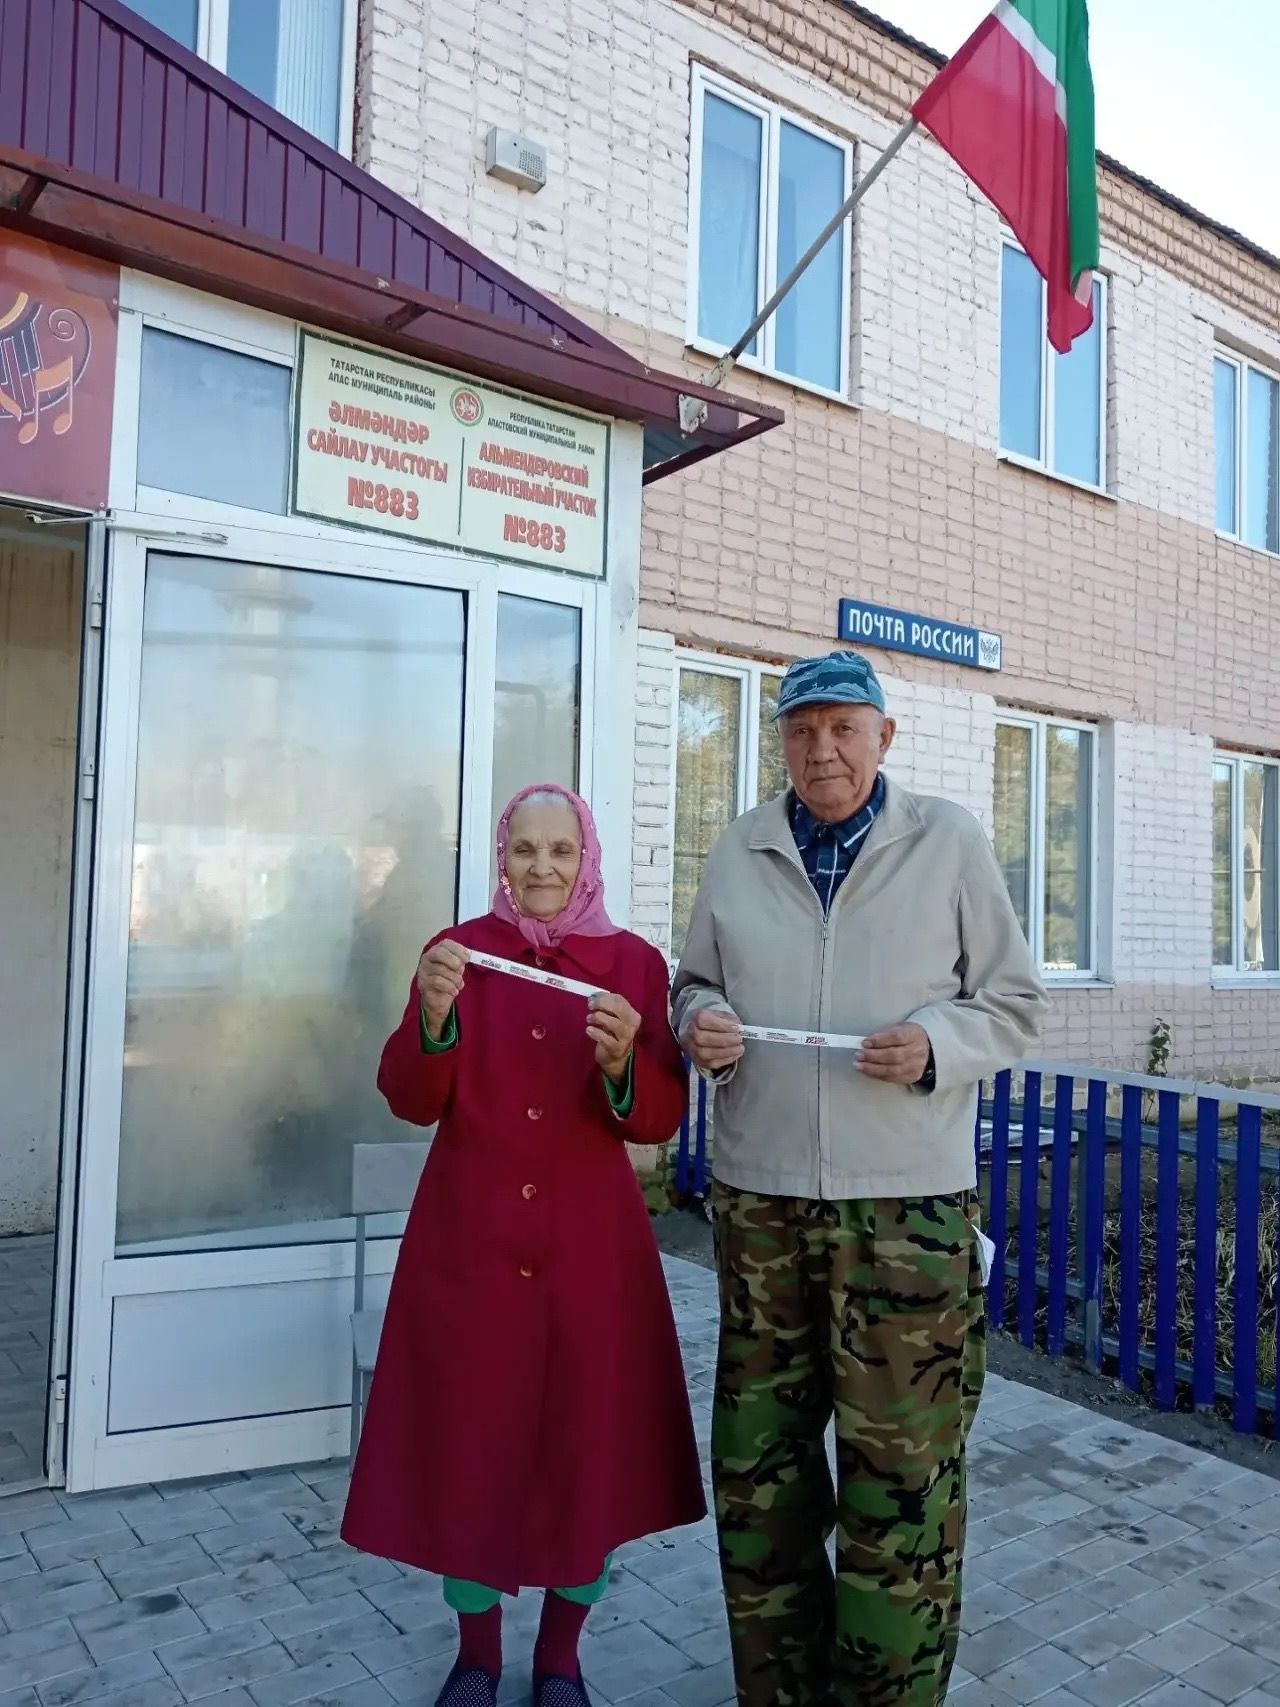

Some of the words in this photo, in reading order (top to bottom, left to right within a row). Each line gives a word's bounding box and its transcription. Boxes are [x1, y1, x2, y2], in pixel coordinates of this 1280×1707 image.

[328, 371, 349, 385] АПАС
[351, 378, 403, 401] МУНИЦИПАЛЬ
[404, 394, 436, 410] РАЙОНЫ
[330, 358, 375, 379] ТАТАРСТАН
[376, 371, 436, 397] РЕСПУБЛИКАСЫ
[328, 400, 430, 444] ӘЛМӘНДӘР
[487, 417, 528, 437] АПАСТОВСКИЙ
[528, 428, 577, 450] МУНИЦИПАЛЬНЫЙ
[577, 443, 595, 456] РАЙОН
[509, 412, 546, 429] РЕСПУБЛИКА
[546, 422, 576, 438] ТАТАРСТАН
[307, 427, 369, 463] САЙЛАУ
[370, 444, 448, 483] УЧАСТОГЫ
[479, 441, 589, 488] АЛЬМЕНДЕРОВСКИЙ
[347, 475, 419, 520] №883
[467, 466, 554, 507] ИЗБИРАТЕЛЬНЫЙ
[554, 489, 597, 518] УЧАСТОК
[503, 513, 566, 553] №883
[848, 608, 905, 643] ПОЧТА
[911, 622, 974, 658] РОССИИ
